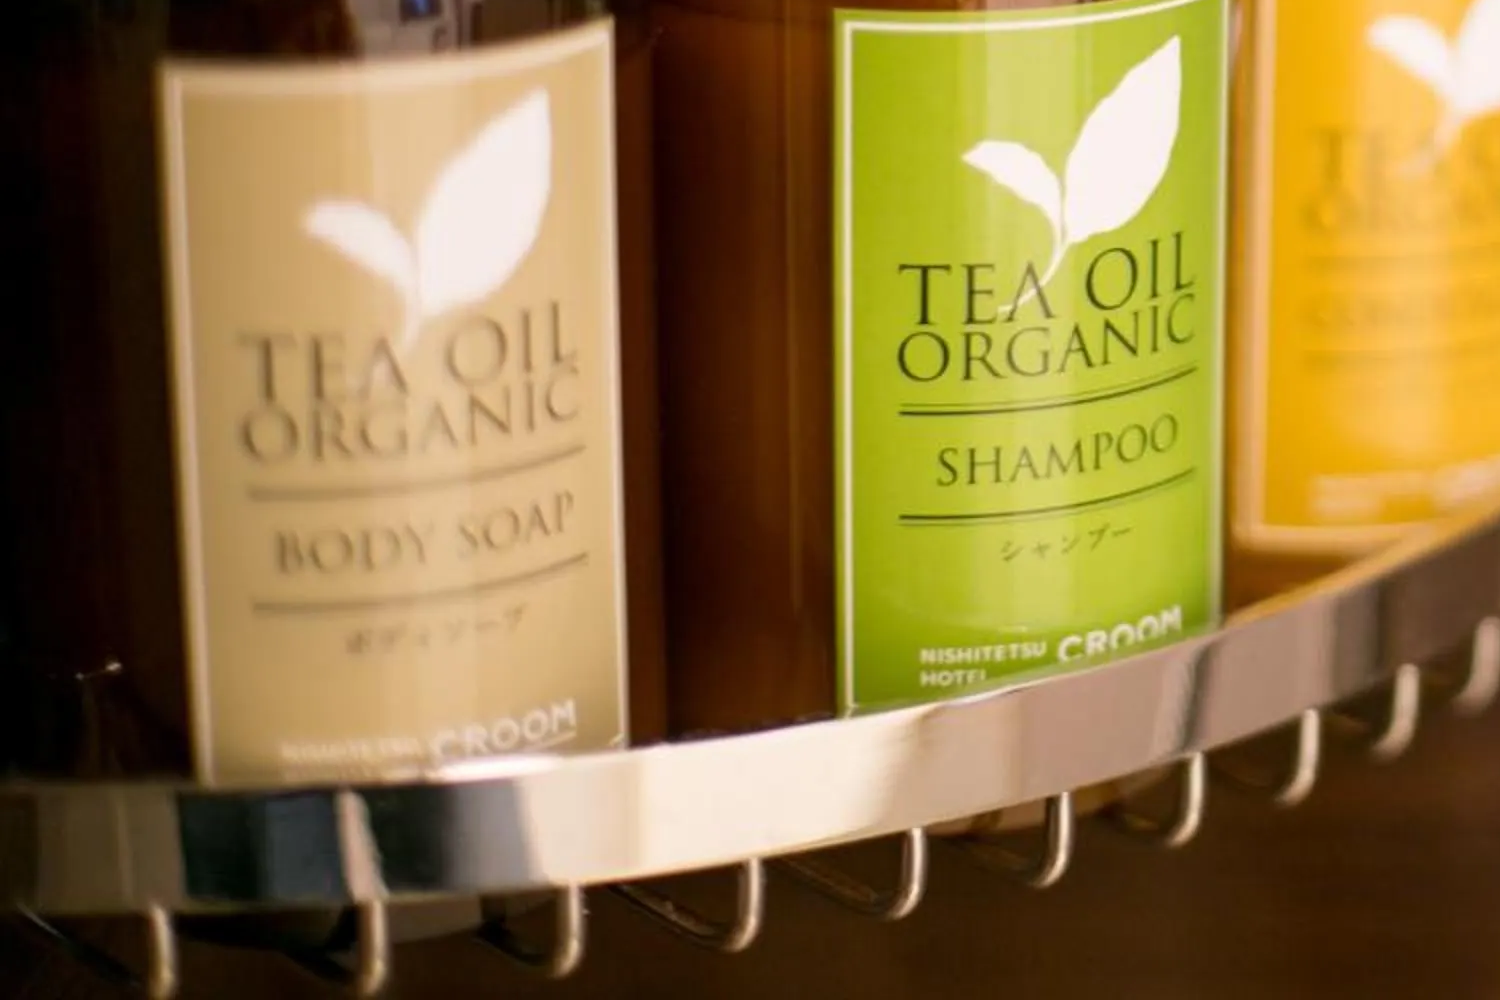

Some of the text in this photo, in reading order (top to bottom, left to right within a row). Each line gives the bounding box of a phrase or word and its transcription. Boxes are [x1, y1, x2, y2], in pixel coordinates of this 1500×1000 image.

[898, 230, 1196, 327] TEA OIL
[234, 300, 582, 403] TEA OIL
[897, 293, 1196, 383] ORGANIC
[239, 368, 581, 467] ORGANIC
[936, 412, 1180, 488] SHAMPOO
[274, 488, 576, 577] BODY SOAP
[919, 604, 1183, 666] NISHITETSU CROOM
[430, 699, 577, 765] CROOM
